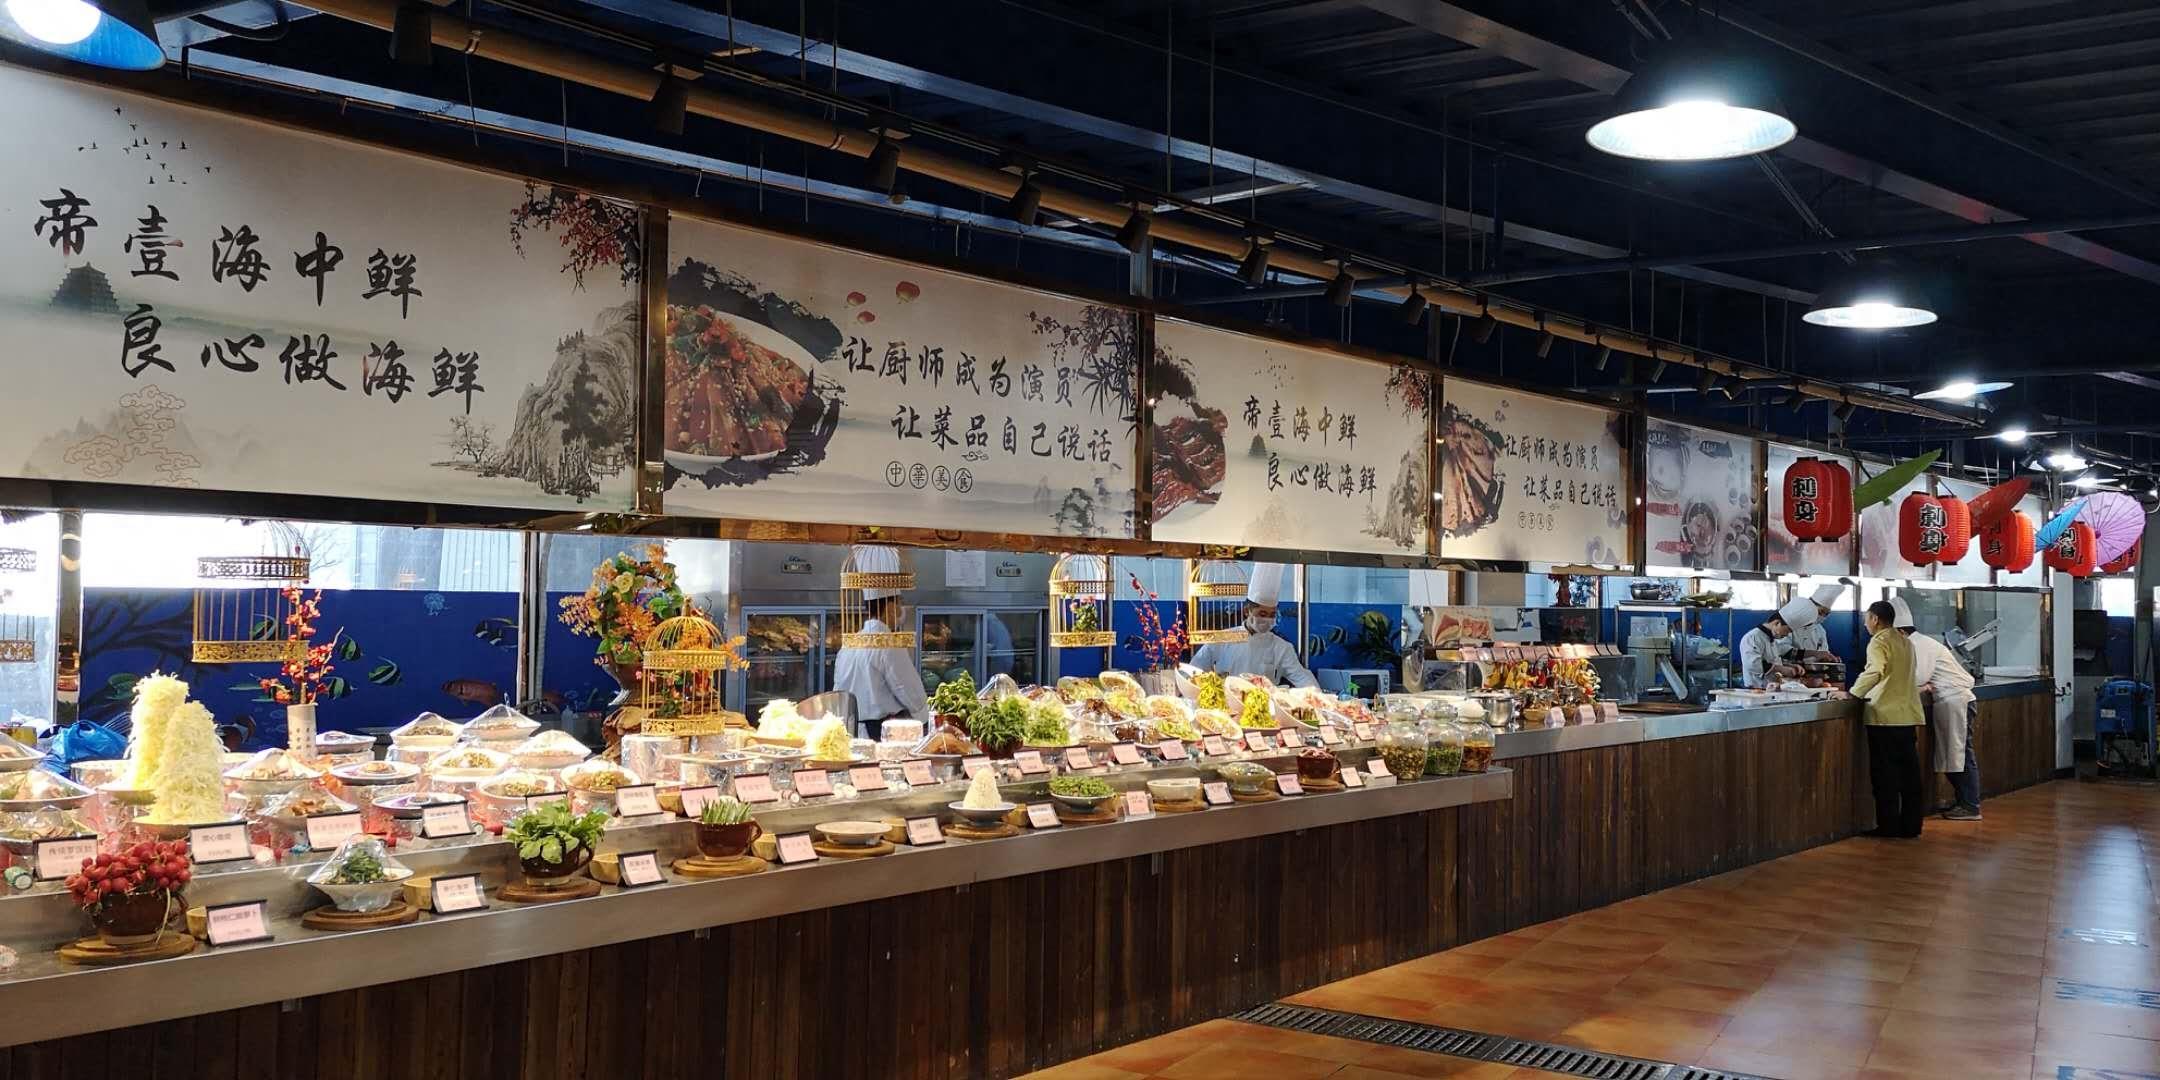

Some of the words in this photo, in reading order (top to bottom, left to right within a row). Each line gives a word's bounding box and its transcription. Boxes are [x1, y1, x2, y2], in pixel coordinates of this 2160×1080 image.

[34, 188, 422, 318] 帝壹海中鲜
[121, 304, 485, 414] 良心做海鲜
[842, 336, 1074, 407] 让厨师成为演员
[891, 404, 1112, 463] 让菜品自己说话
[1243, 395, 1357, 450] 帝壹海中鲜
[1267, 452, 1377, 501] 良心做海鲜
[1504, 434, 1599, 472] 让厨师成为演员
